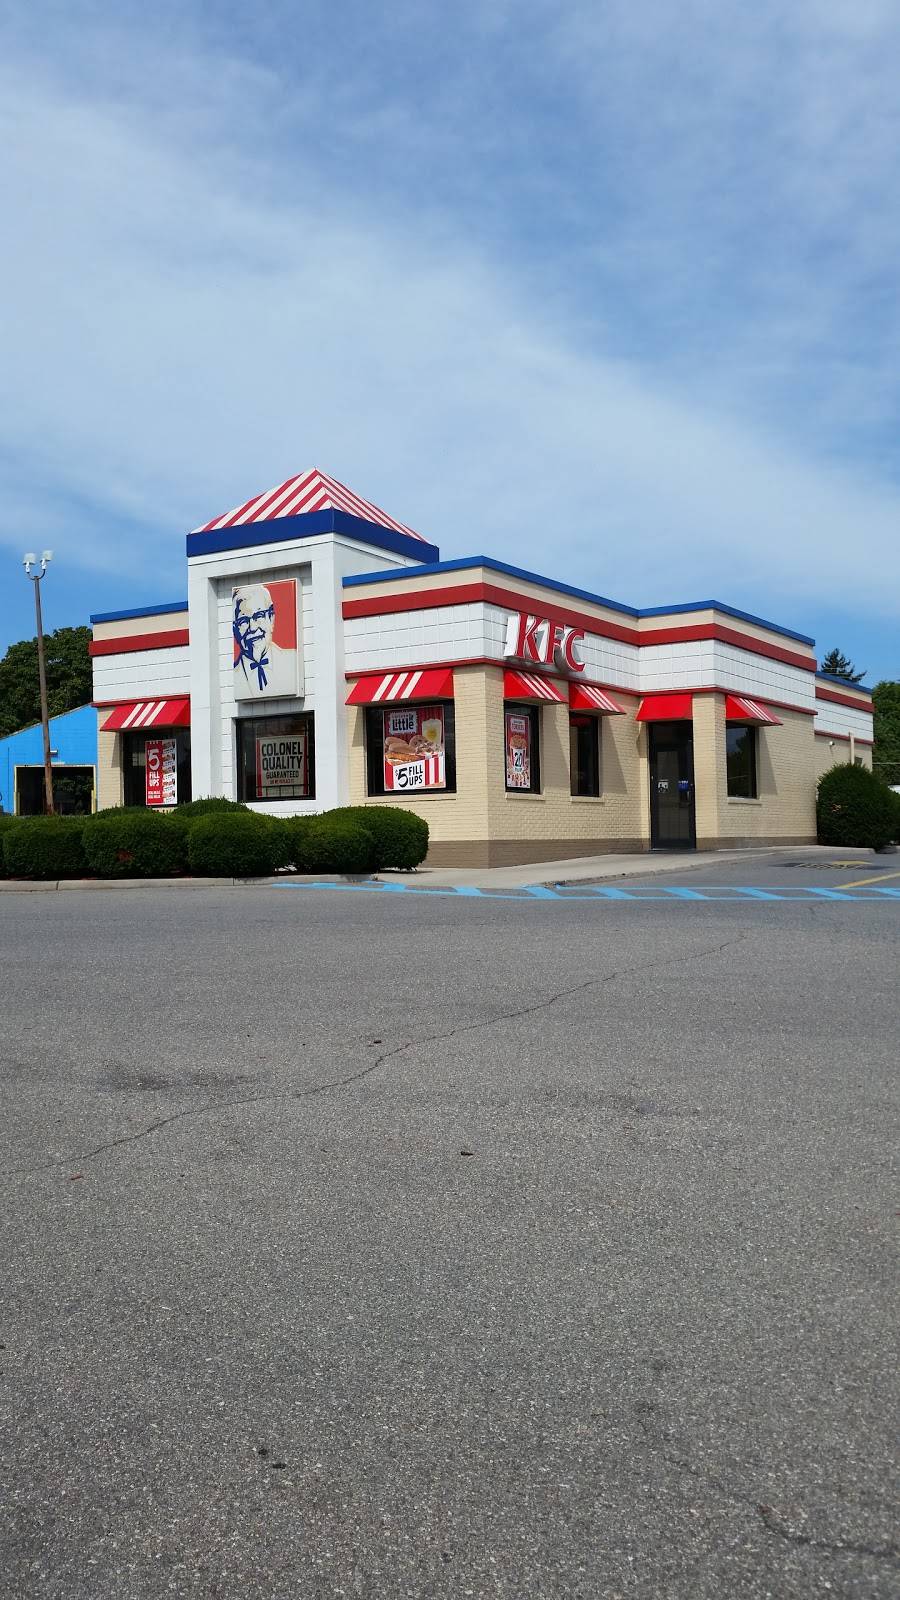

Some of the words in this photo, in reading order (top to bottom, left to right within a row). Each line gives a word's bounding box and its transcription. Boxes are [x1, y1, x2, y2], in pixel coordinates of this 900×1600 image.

[505, 613, 586, 672] KFC
[261, 742, 303, 756] COLONEL
[262, 756, 303, 771] QUALITY
[409, 764, 423, 775] FILL
[266, 770, 299, 779] GUARANTEED
[409, 774, 423, 786] UPS
